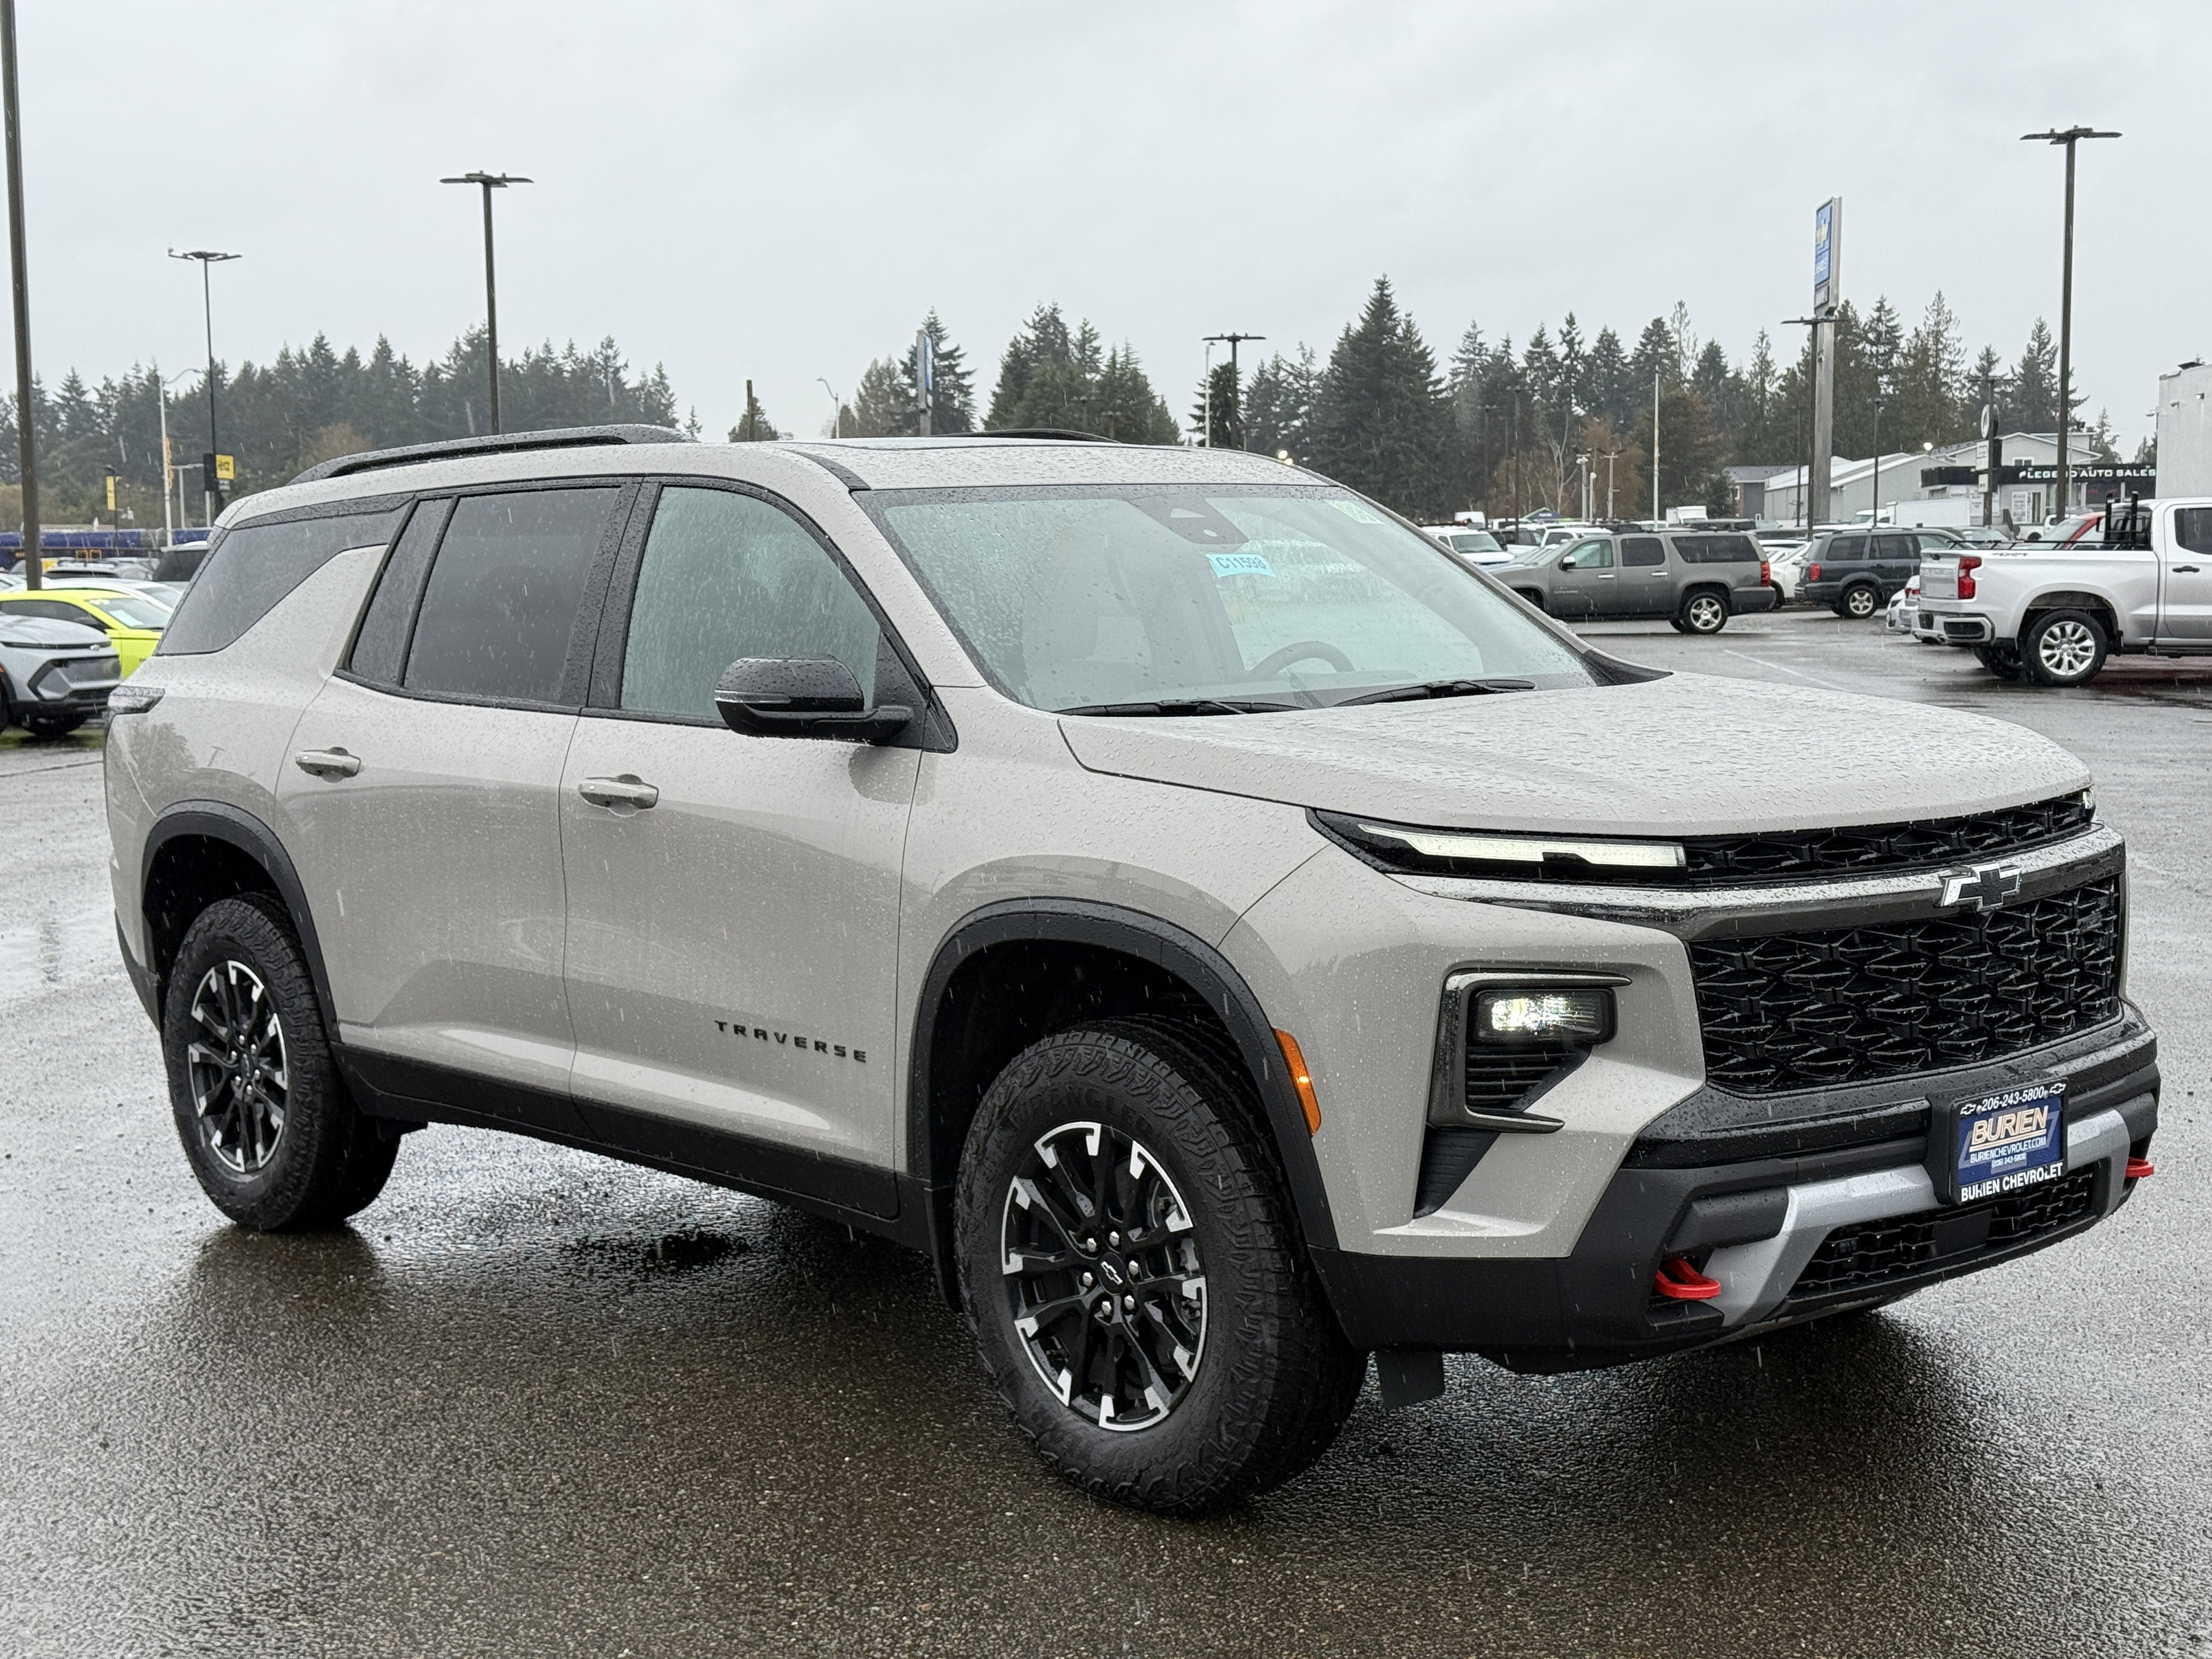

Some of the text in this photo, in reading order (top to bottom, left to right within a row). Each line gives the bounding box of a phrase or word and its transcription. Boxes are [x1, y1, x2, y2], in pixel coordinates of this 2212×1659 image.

[2027, 469, 2156, 479] LEGED AUTO SALES
[1215, 557, 1266, 569] C11598
[714, 1020, 866, 1063] TRAVERSE
[1982, 1086, 2045, 1111] 206-243-5800
[1972, 1105, 2049, 1145] BURIEN
[1970, 1136, 2046, 1164] BURIENCHEVROLET.COM
[1961, 1162, 2063, 1202] BURIEN CHEVROLET
